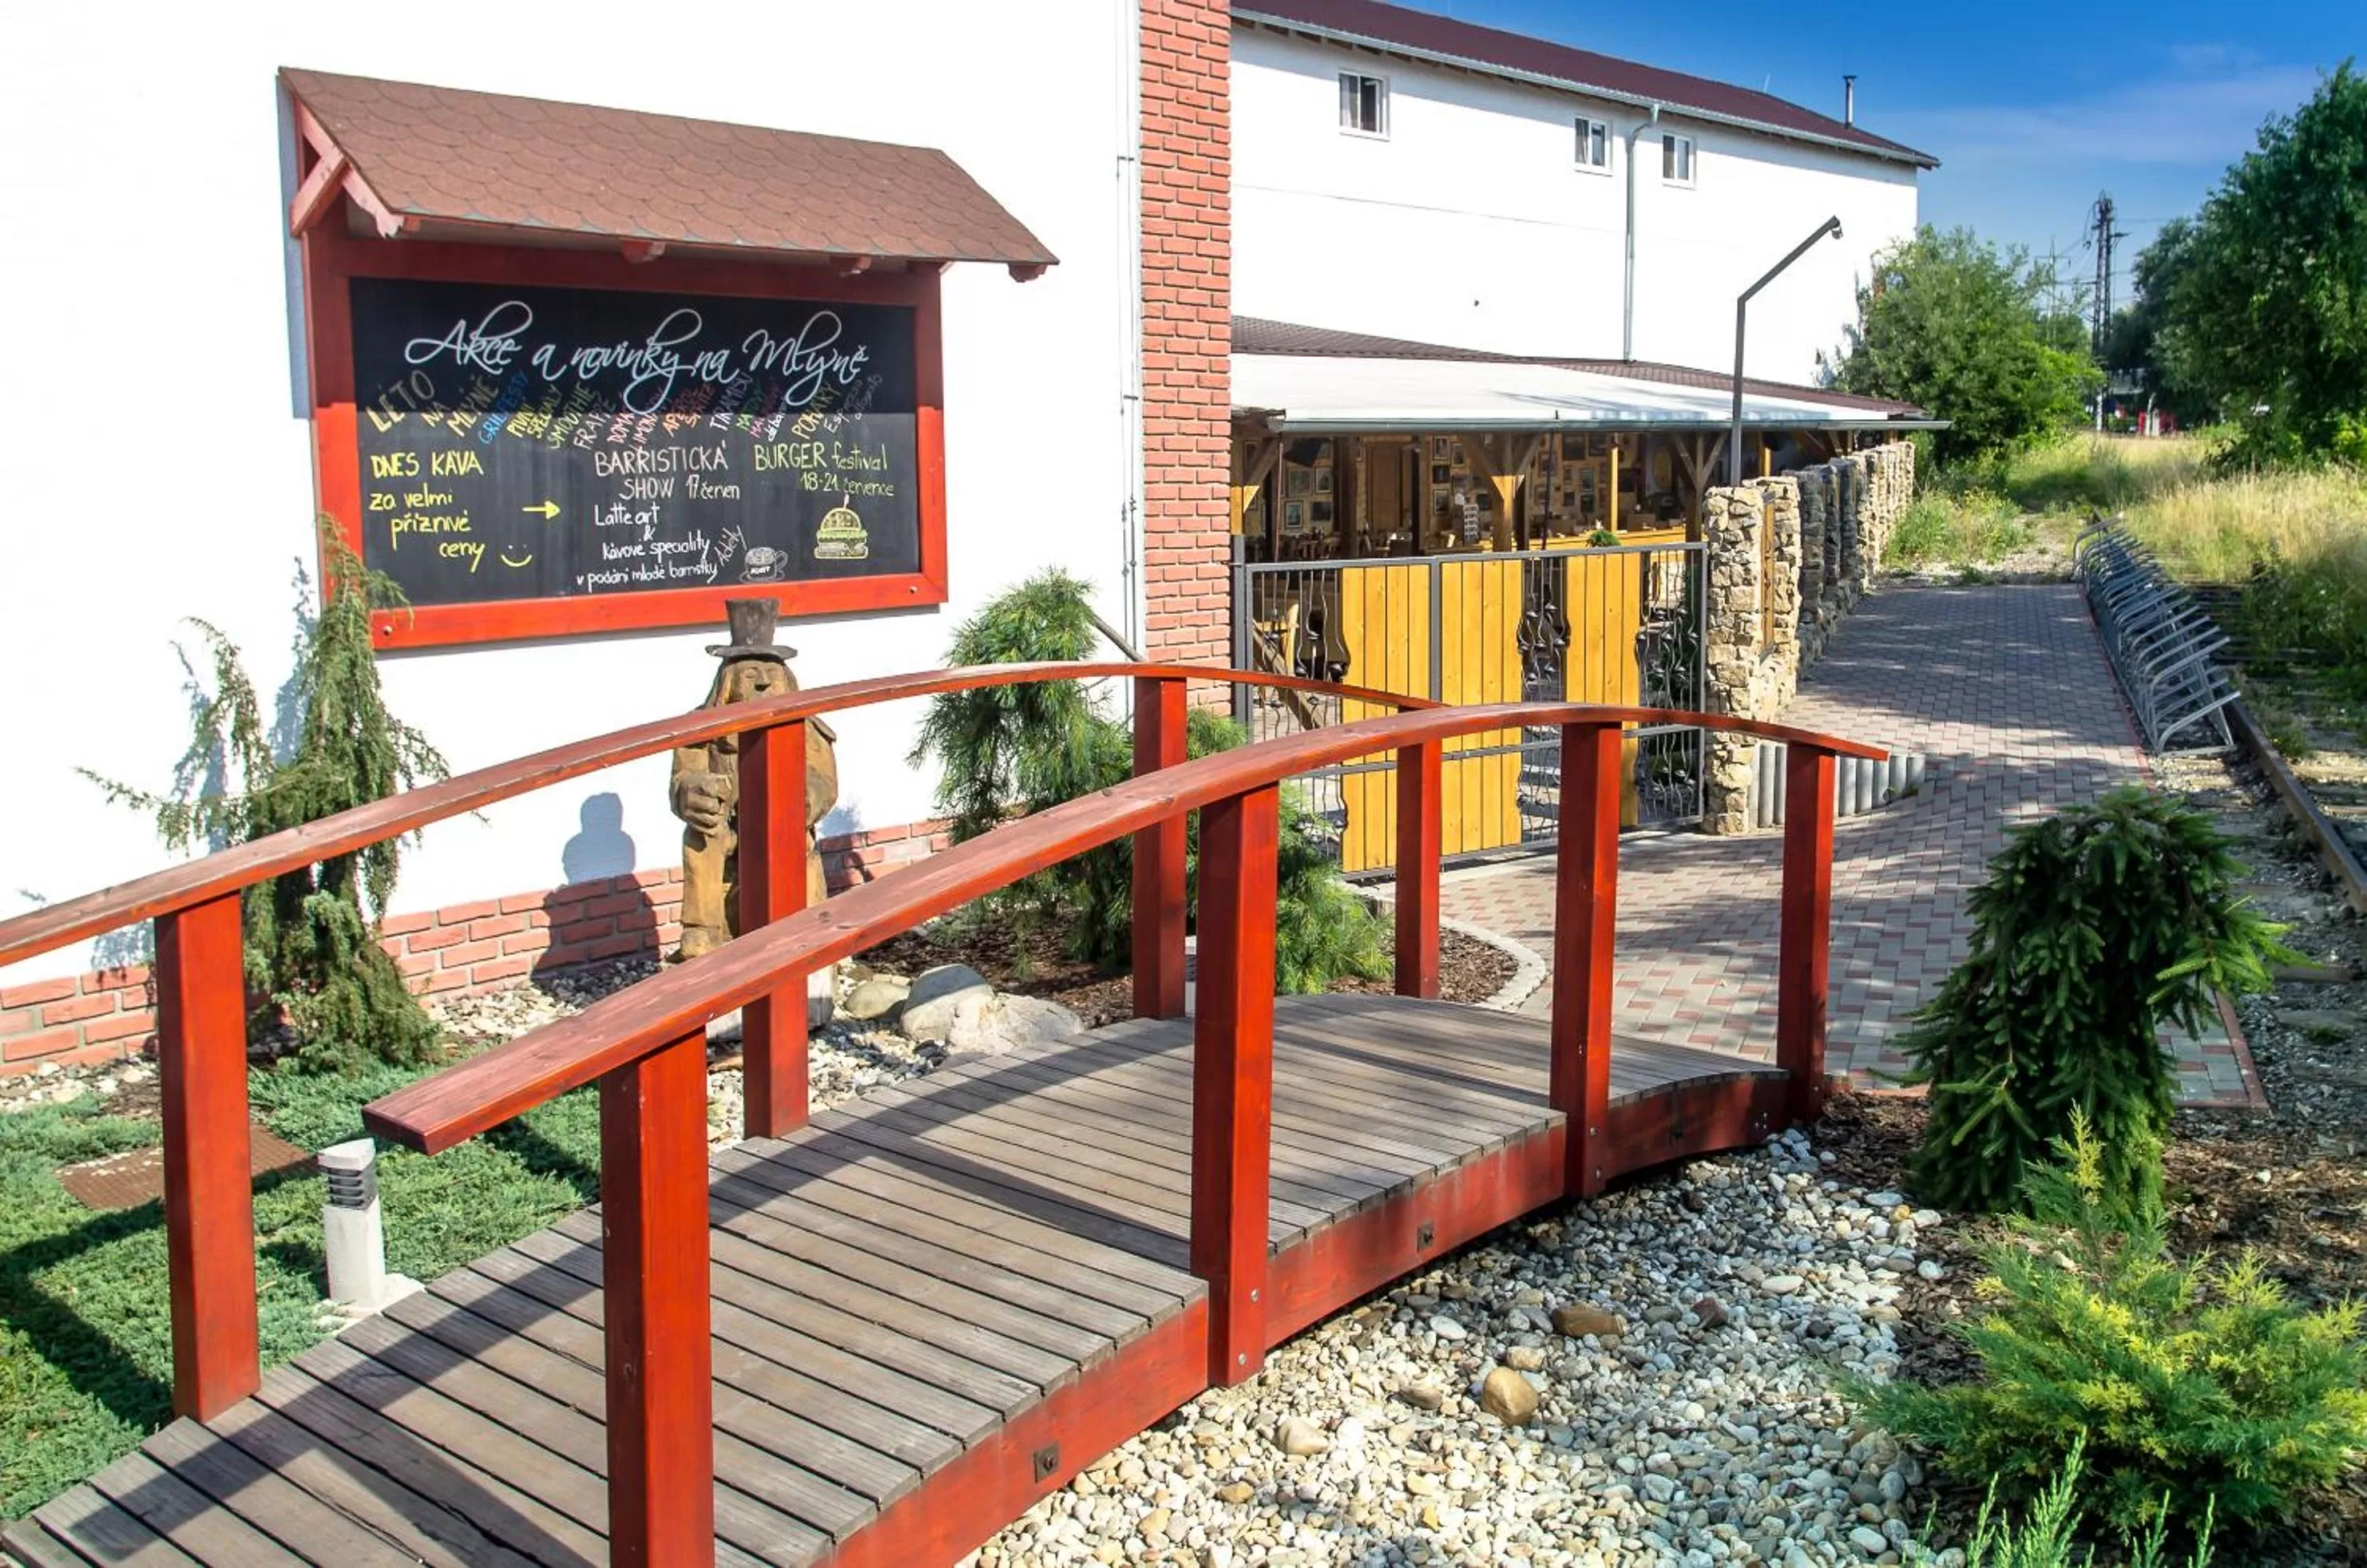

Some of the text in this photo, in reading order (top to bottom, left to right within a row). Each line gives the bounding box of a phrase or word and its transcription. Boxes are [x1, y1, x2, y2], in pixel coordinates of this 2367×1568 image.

[405, 301, 533, 374] Akce
[532, 343, 568, 381] a
[571, 309, 702, 415] novinky
[693, 348, 739, 383] na
[422, 401, 451, 428] NA
[370, 452, 420, 478] DNES
[595, 440, 728, 477] BARRISTICKÁ
[753, 441, 889, 471] BURGER festival
[368, 482, 453, 511] za velmi
[618, 477, 675, 501] SHOW
[594, 501, 660, 526] Latte art
[439, 541, 486, 573] ceny
